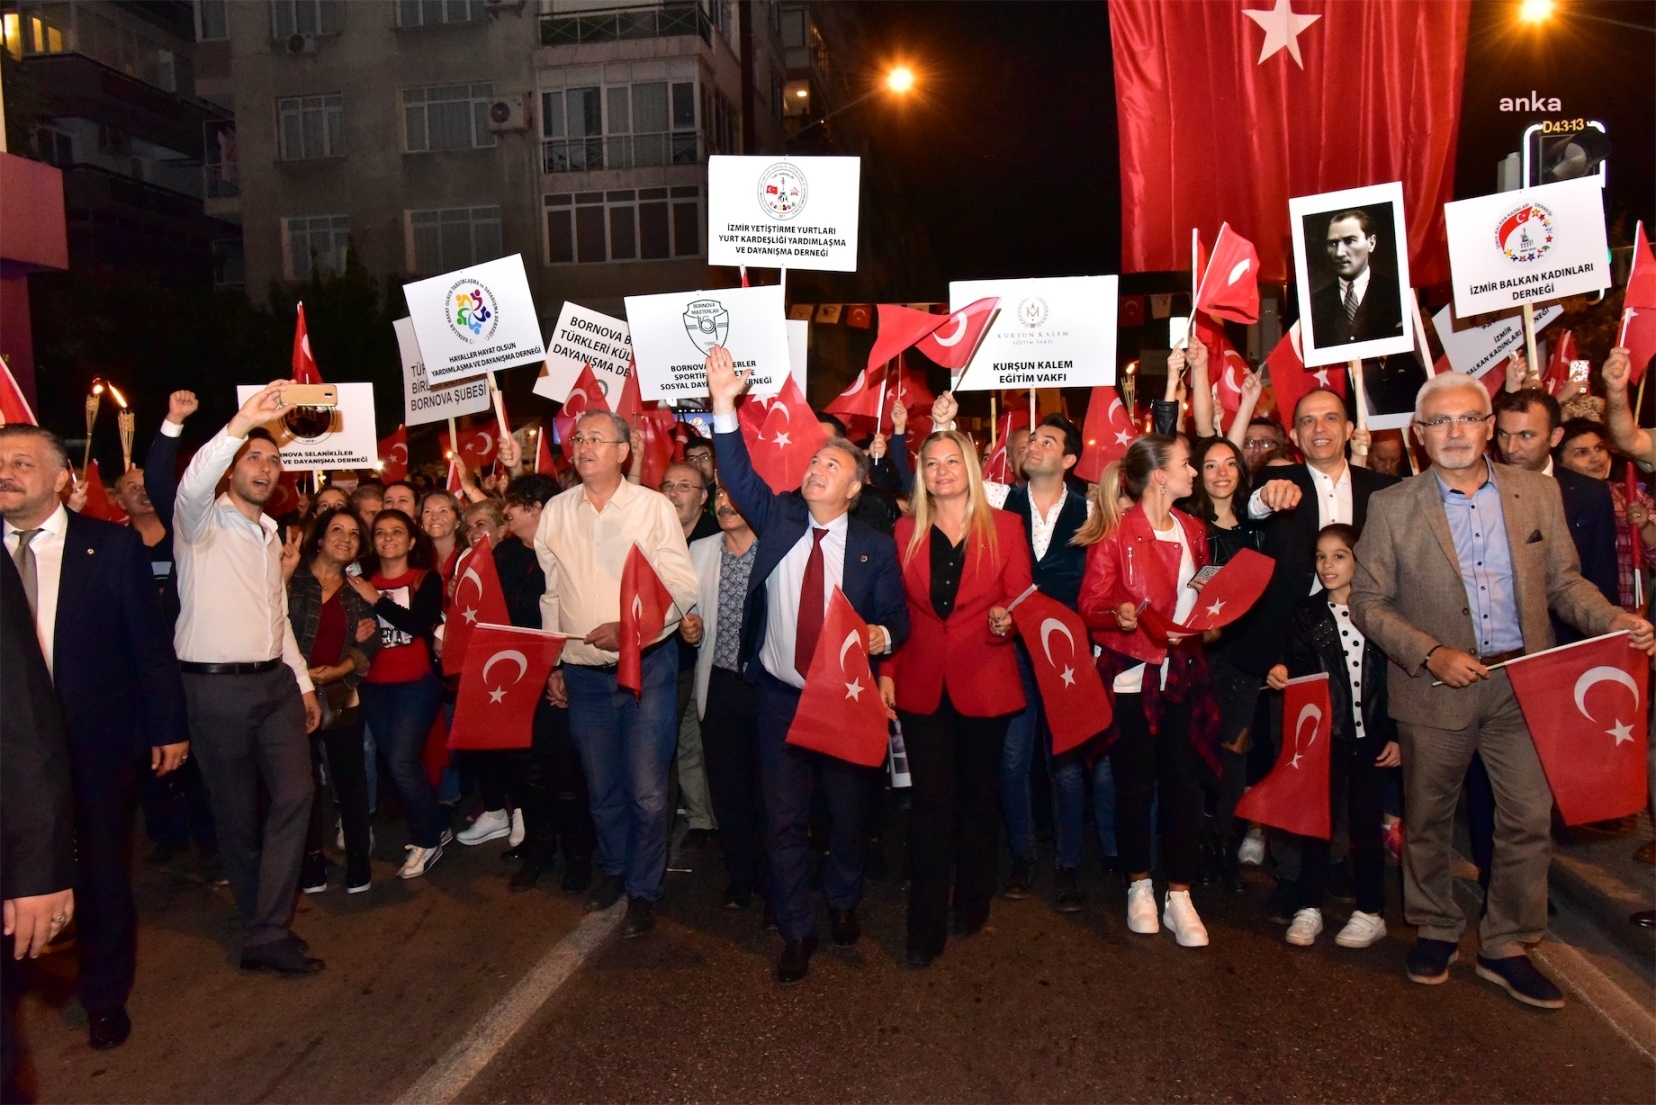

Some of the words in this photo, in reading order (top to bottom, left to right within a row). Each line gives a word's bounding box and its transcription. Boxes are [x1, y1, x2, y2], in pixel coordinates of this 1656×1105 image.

[1542, 118, 1585, 134] D43-13
[727, 223, 750, 232] İZMİR
[751, 224, 796, 234] YETİŞTİRME
[798, 226, 836, 235] YURTLARI
[740, 236, 787, 245] KARDEŞLİĞİ
[788, 238, 846, 248] YARDIMLAŞMA
[747, 247, 792, 257] DAYANIŞMA
[794, 248, 828, 257] DERNEĞİ
[1470, 282, 1498, 295] İZMİR
[1500, 274, 1539, 290] BALKAN
[1540, 262, 1594, 281] KADINLARI
[1512, 282, 1554, 300] DERNEĞİ
[570, 316, 622, 342] BORNOVA
[624, 335, 632, 346] B
[1494, 326, 1512, 343] İZMİR
[560, 329, 611, 354] TÜRKLERİ
[1489, 330, 1522, 358] KADINLARI
[449, 351, 477, 363] HAYALLER
[478, 346, 496, 356] HAYAT
[496, 342, 516, 352] OLSUN
[552, 343, 613, 373] DAYANIŞMA
[615, 365, 630, 377] DE
[431, 362, 473, 377] YARDIMLAŞMA
[482, 354, 515, 366] DAYANIŞMA
[515, 346, 541, 358] DERNEĞİ
[733, 360, 756, 368] ERLER
[993, 361, 1035, 372] KURŞUN
[1037, 360, 1073, 370] KALEM
[660, 382, 689, 390] SOSYAL
[1000, 373, 1035, 383] EĞİTİM
[1036, 373, 1067, 382] VAKFI
[411, 392, 453, 411] BORNOVA
[454, 380, 486, 405] ŞUBESİ
